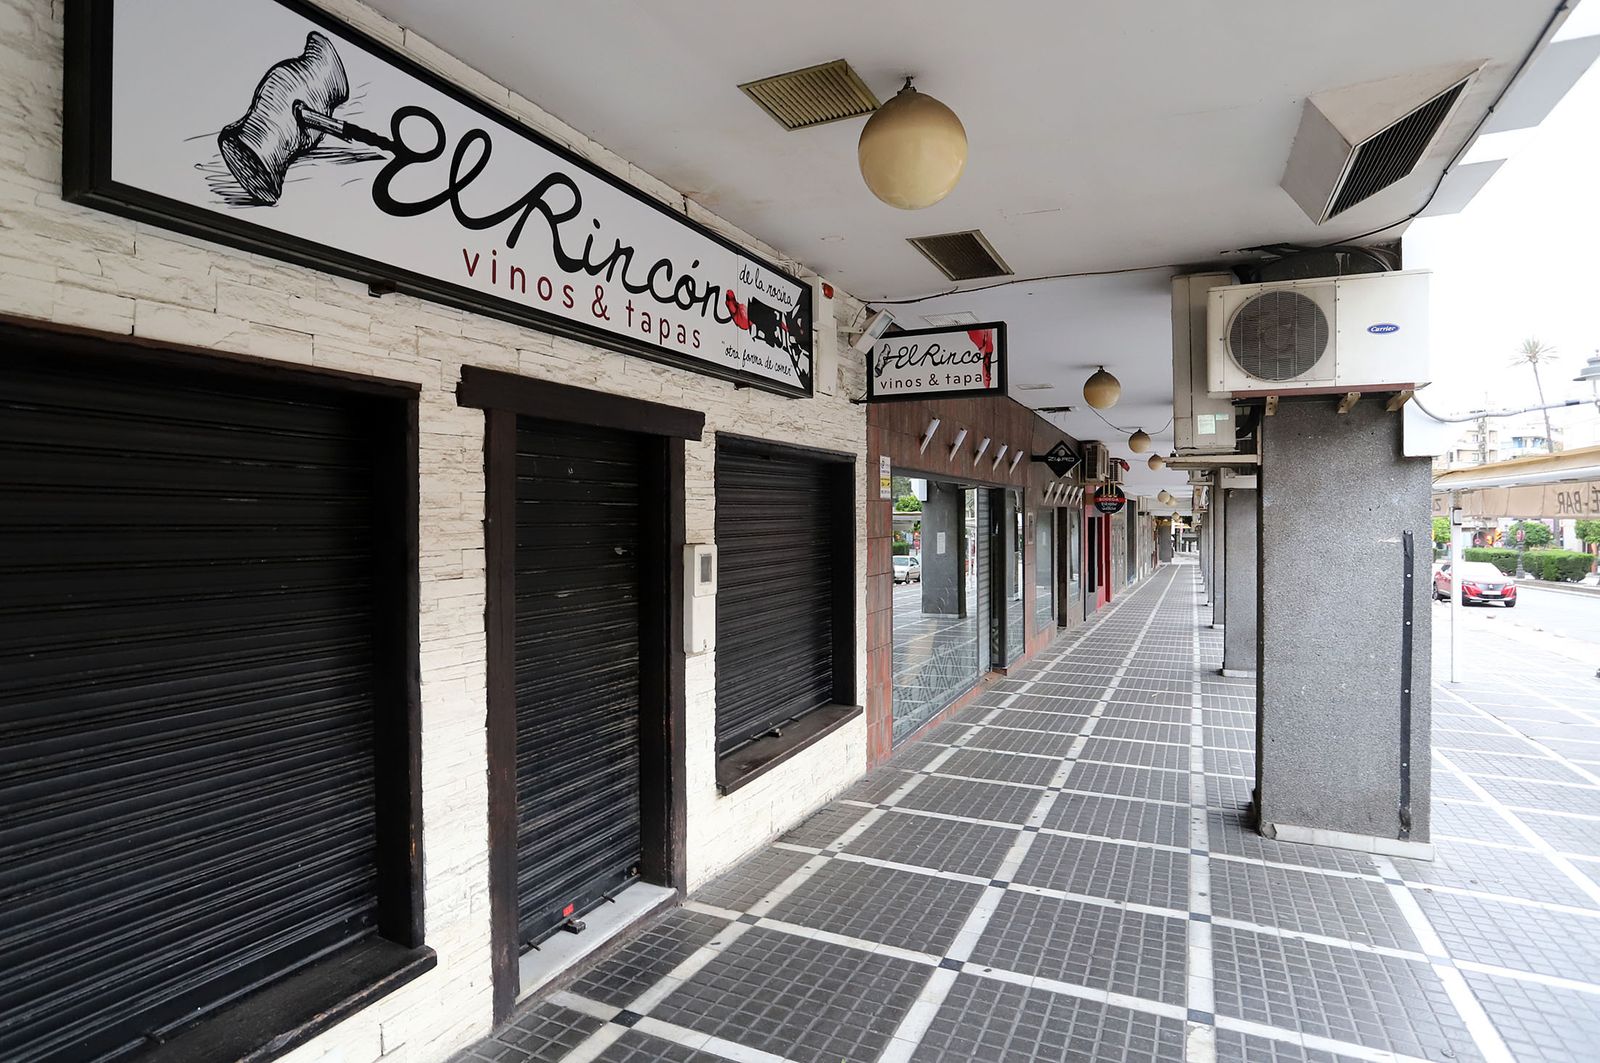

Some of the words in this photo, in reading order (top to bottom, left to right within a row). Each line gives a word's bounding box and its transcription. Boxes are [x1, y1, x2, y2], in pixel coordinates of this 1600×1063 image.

[372, 106, 500, 230] El
[506, 172, 735, 324] Rincón
[740, 264, 753, 285] de
[755, 268, 765, 291] la
[462, 248, 575, 309] vinos
[591, 284, 611, 322] &
[625, 299, 702, 349] tapas
[1370, 325, 1397, 333] Carrier
[742, 349, 763, 367] forma
[765, 356, 773, 370] de
[895, 344, 918, 369] El
[880, 378, 922, 389] vinos
[929, 373, 940, 386] &
[945, 373, 985, 387] tapa
